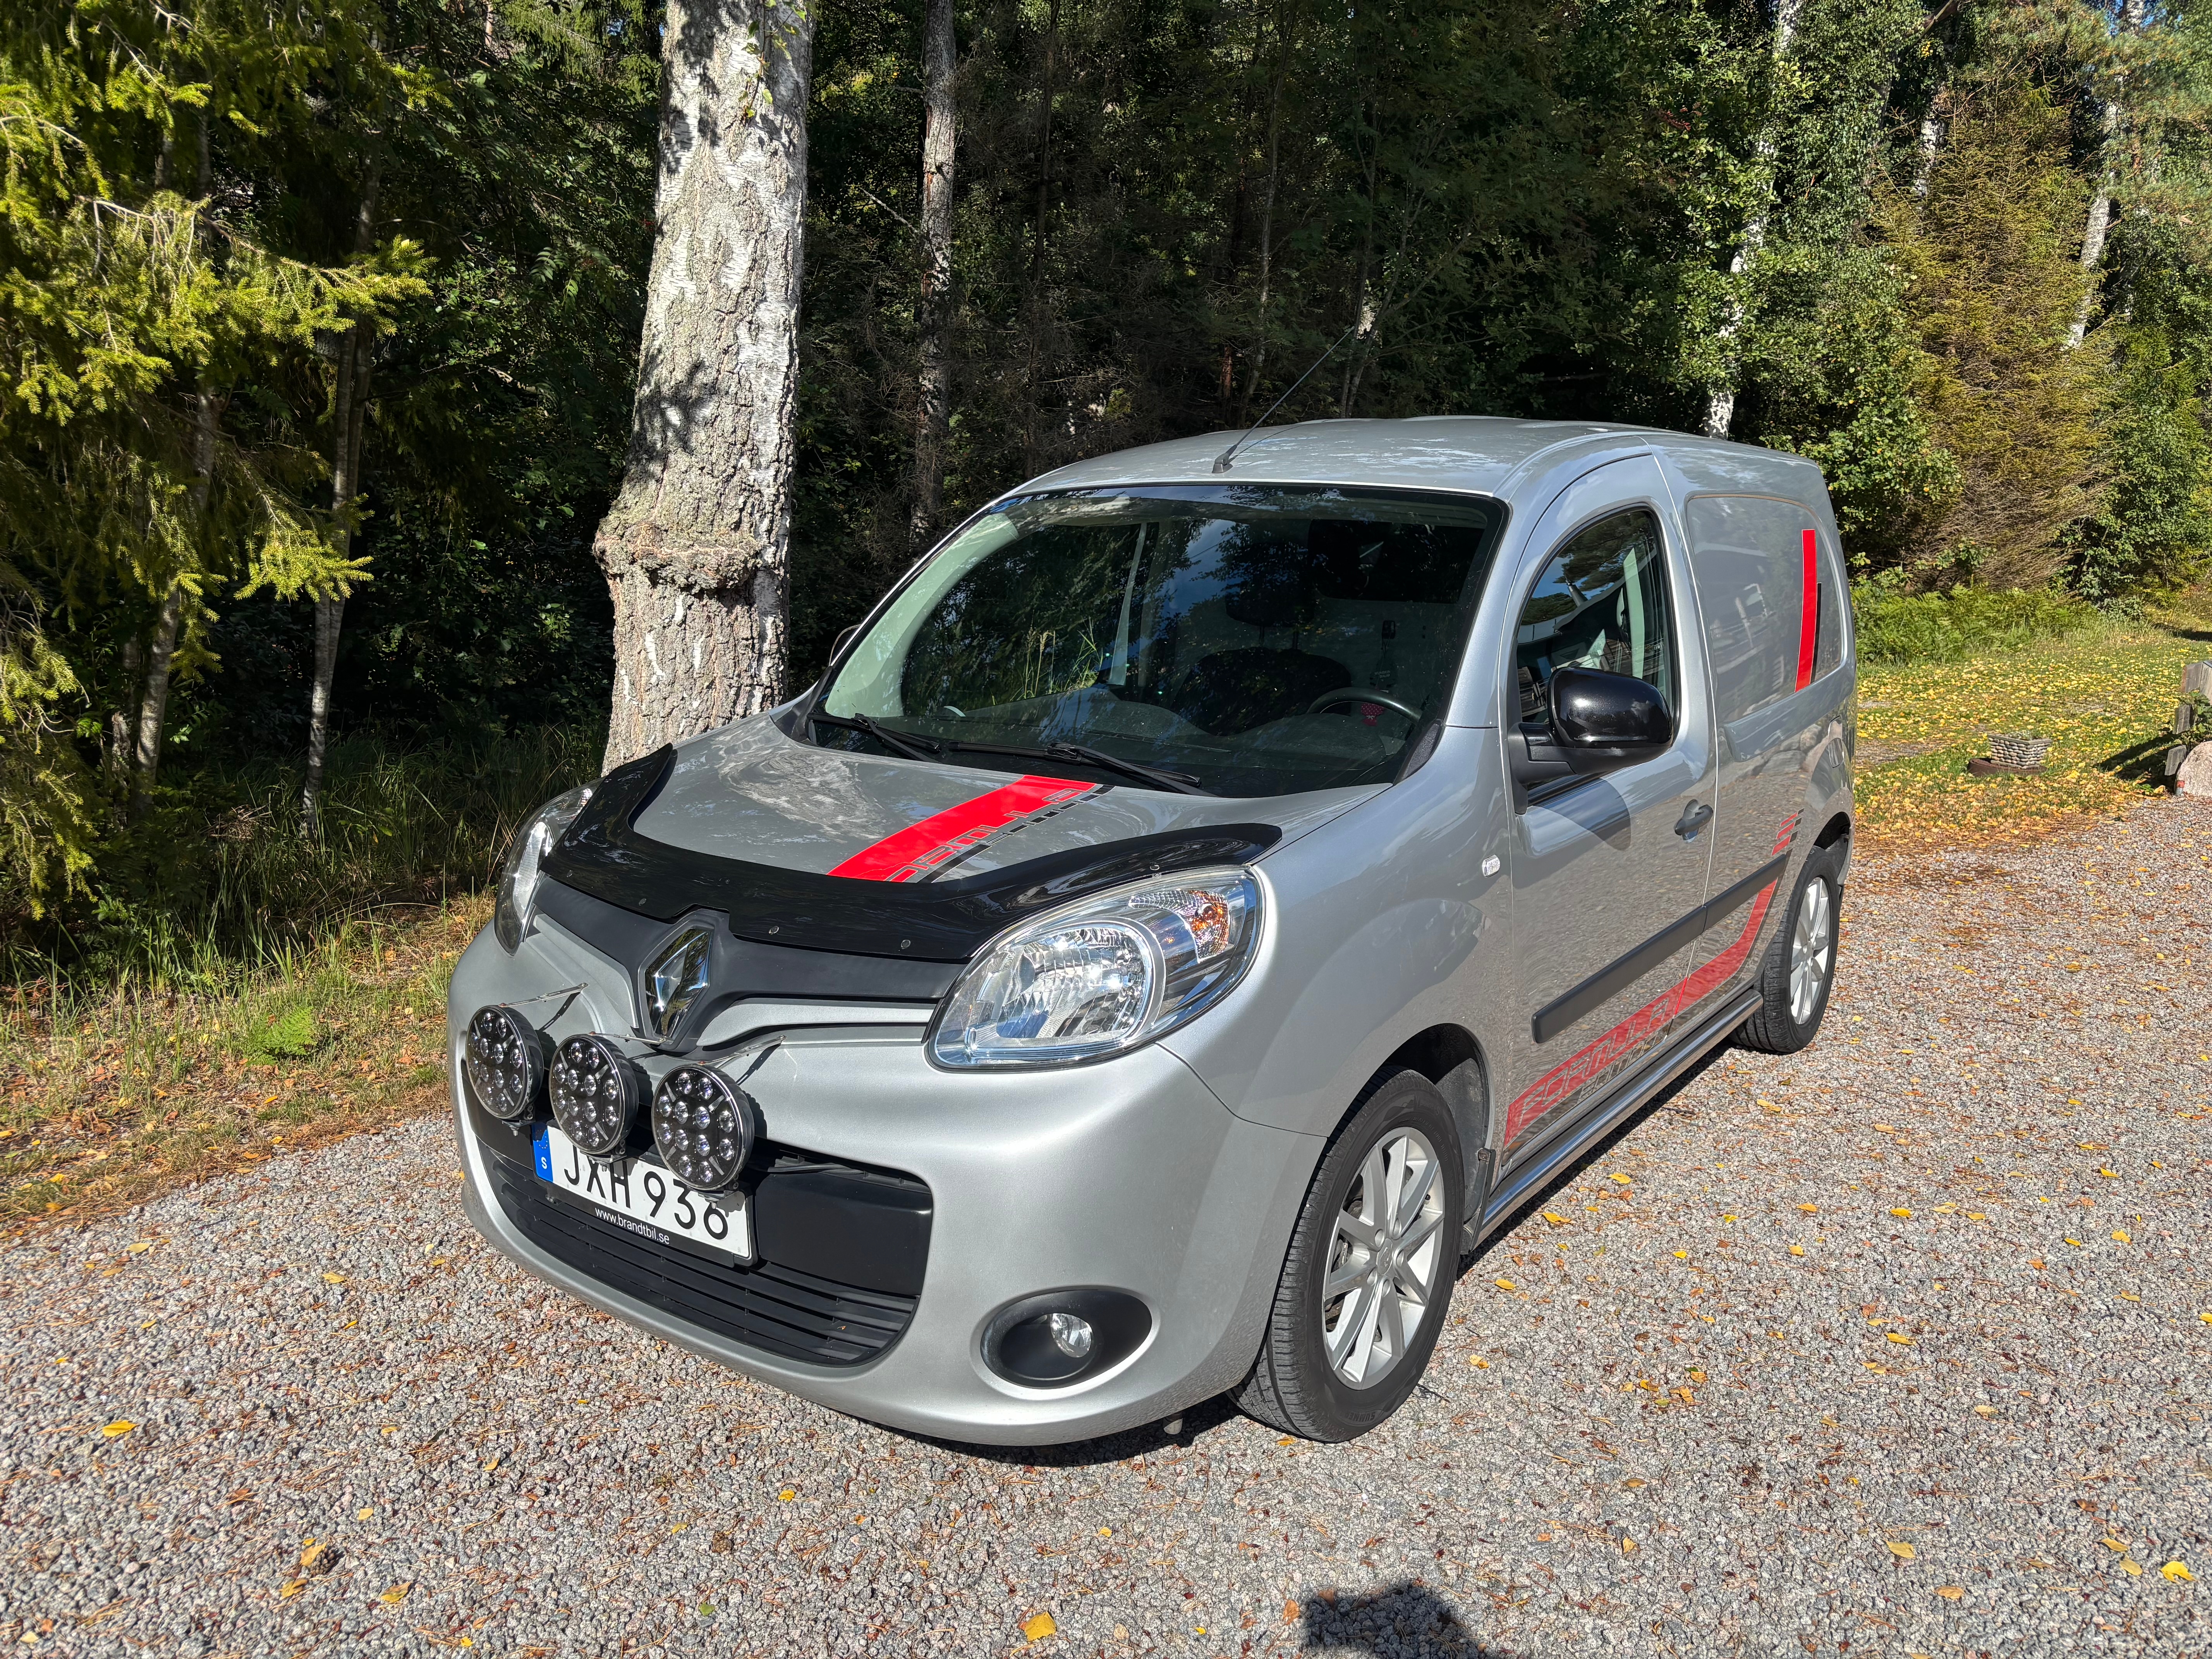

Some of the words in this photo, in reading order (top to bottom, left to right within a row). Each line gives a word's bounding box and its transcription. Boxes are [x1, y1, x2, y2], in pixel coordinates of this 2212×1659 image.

[1517, 997, 1669, 1128] FORMULA
[541, 1156, 547, 1169] S
[564, 1144, 631, 1209] JXH
[644, 1171, 728, 1240] 936
[595, 1207, 670, 1244] www.brandtbil.se
